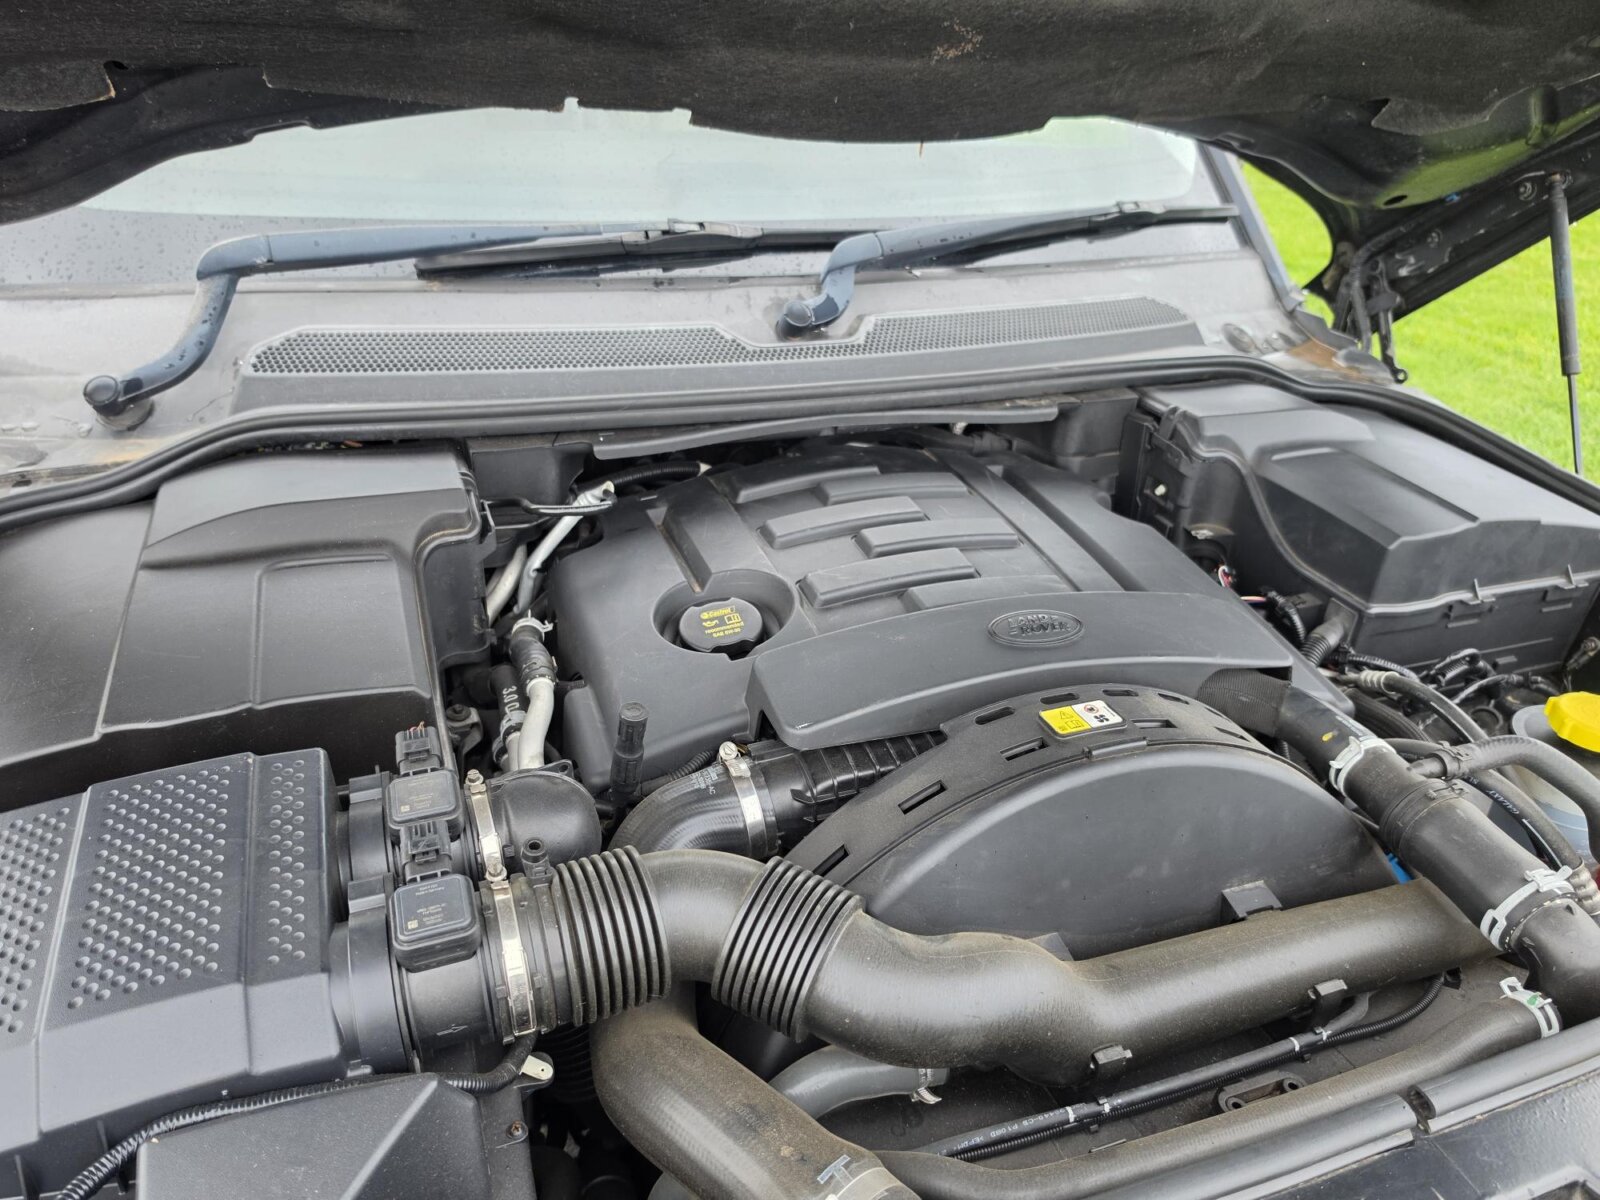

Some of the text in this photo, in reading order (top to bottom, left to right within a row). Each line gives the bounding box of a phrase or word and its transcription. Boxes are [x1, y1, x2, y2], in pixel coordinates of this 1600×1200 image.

[1007, 614, 1049, 628] LAND
[1020, 621, 1073, 636] ROVER
[1486, 790, 1520, 814] GALAXY
